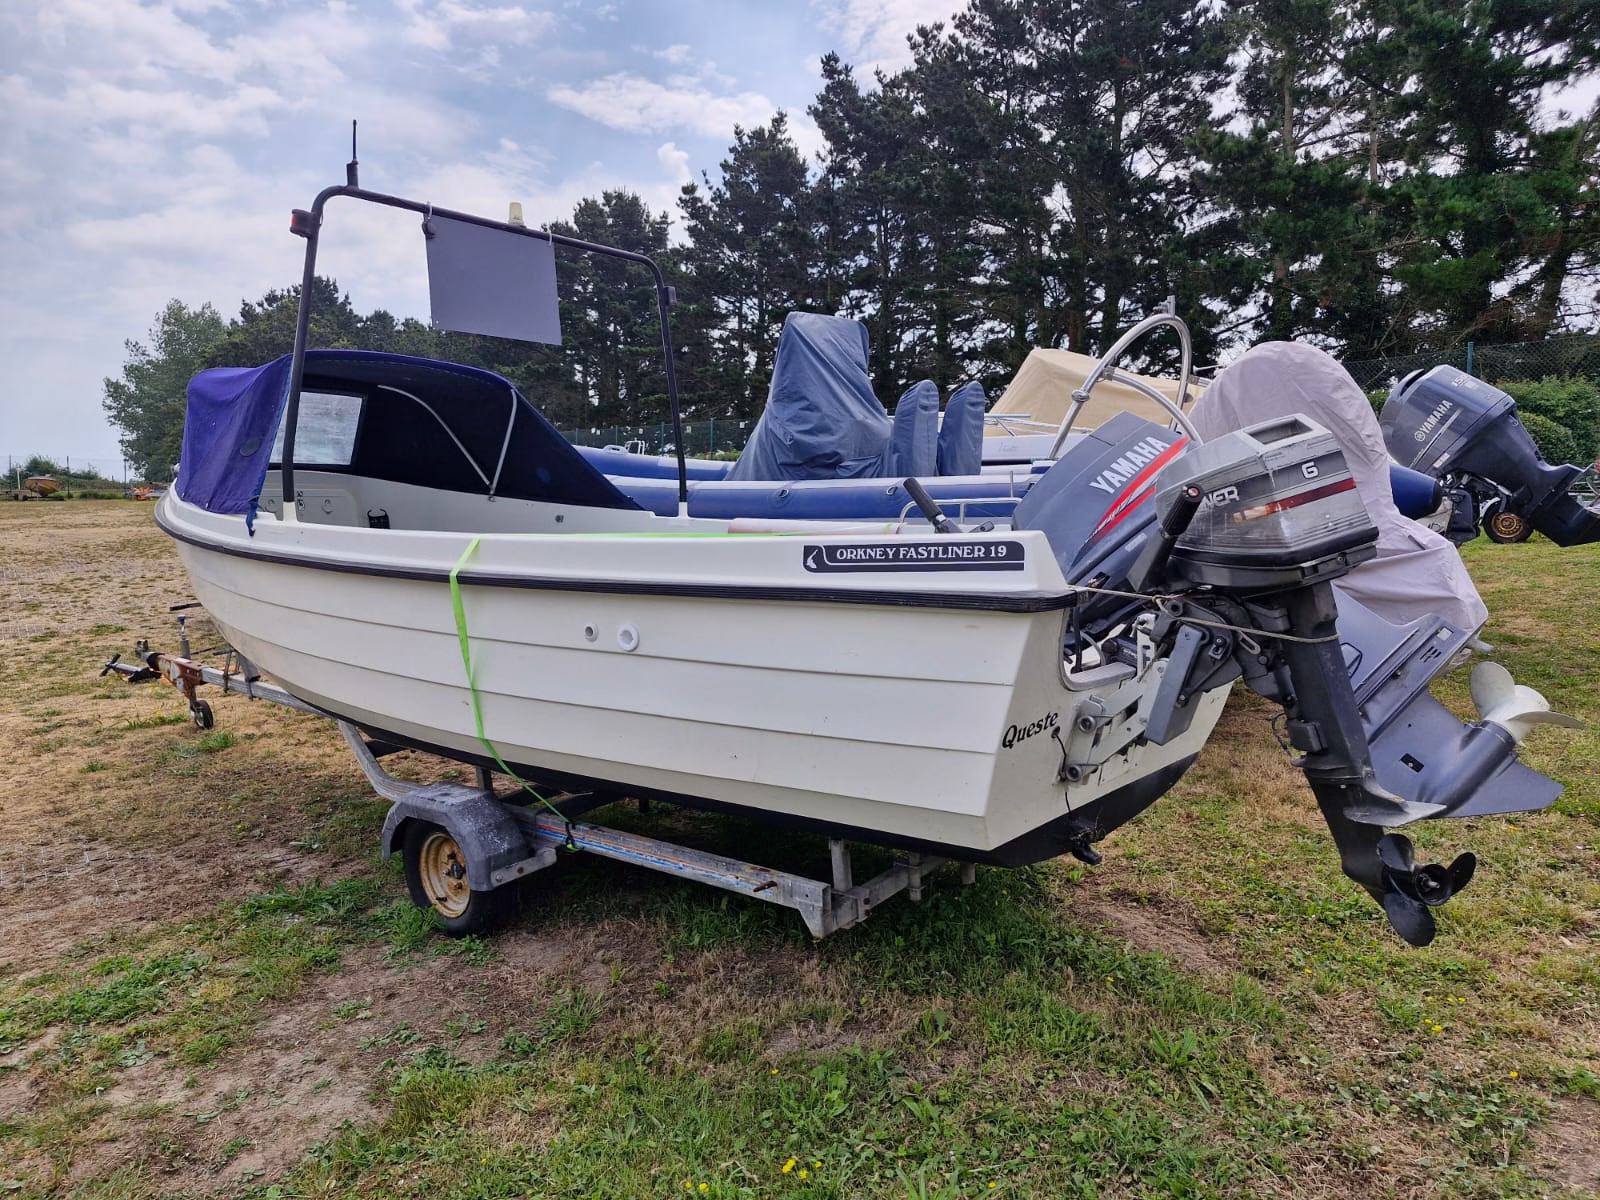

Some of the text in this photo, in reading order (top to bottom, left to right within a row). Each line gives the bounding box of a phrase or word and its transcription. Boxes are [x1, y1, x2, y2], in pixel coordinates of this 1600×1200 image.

[1419, 400, 1453, 434] YAMAHA
[1088, 436, 1171, 494] YAMAHA
[1301, 462, 1319, 479] 6
[1200, 486, 1240, 508] NER
[836, 545, 1007, 560] ORKNEY FASTLINER 19
[1002, 711, 1058, 749] Queste
